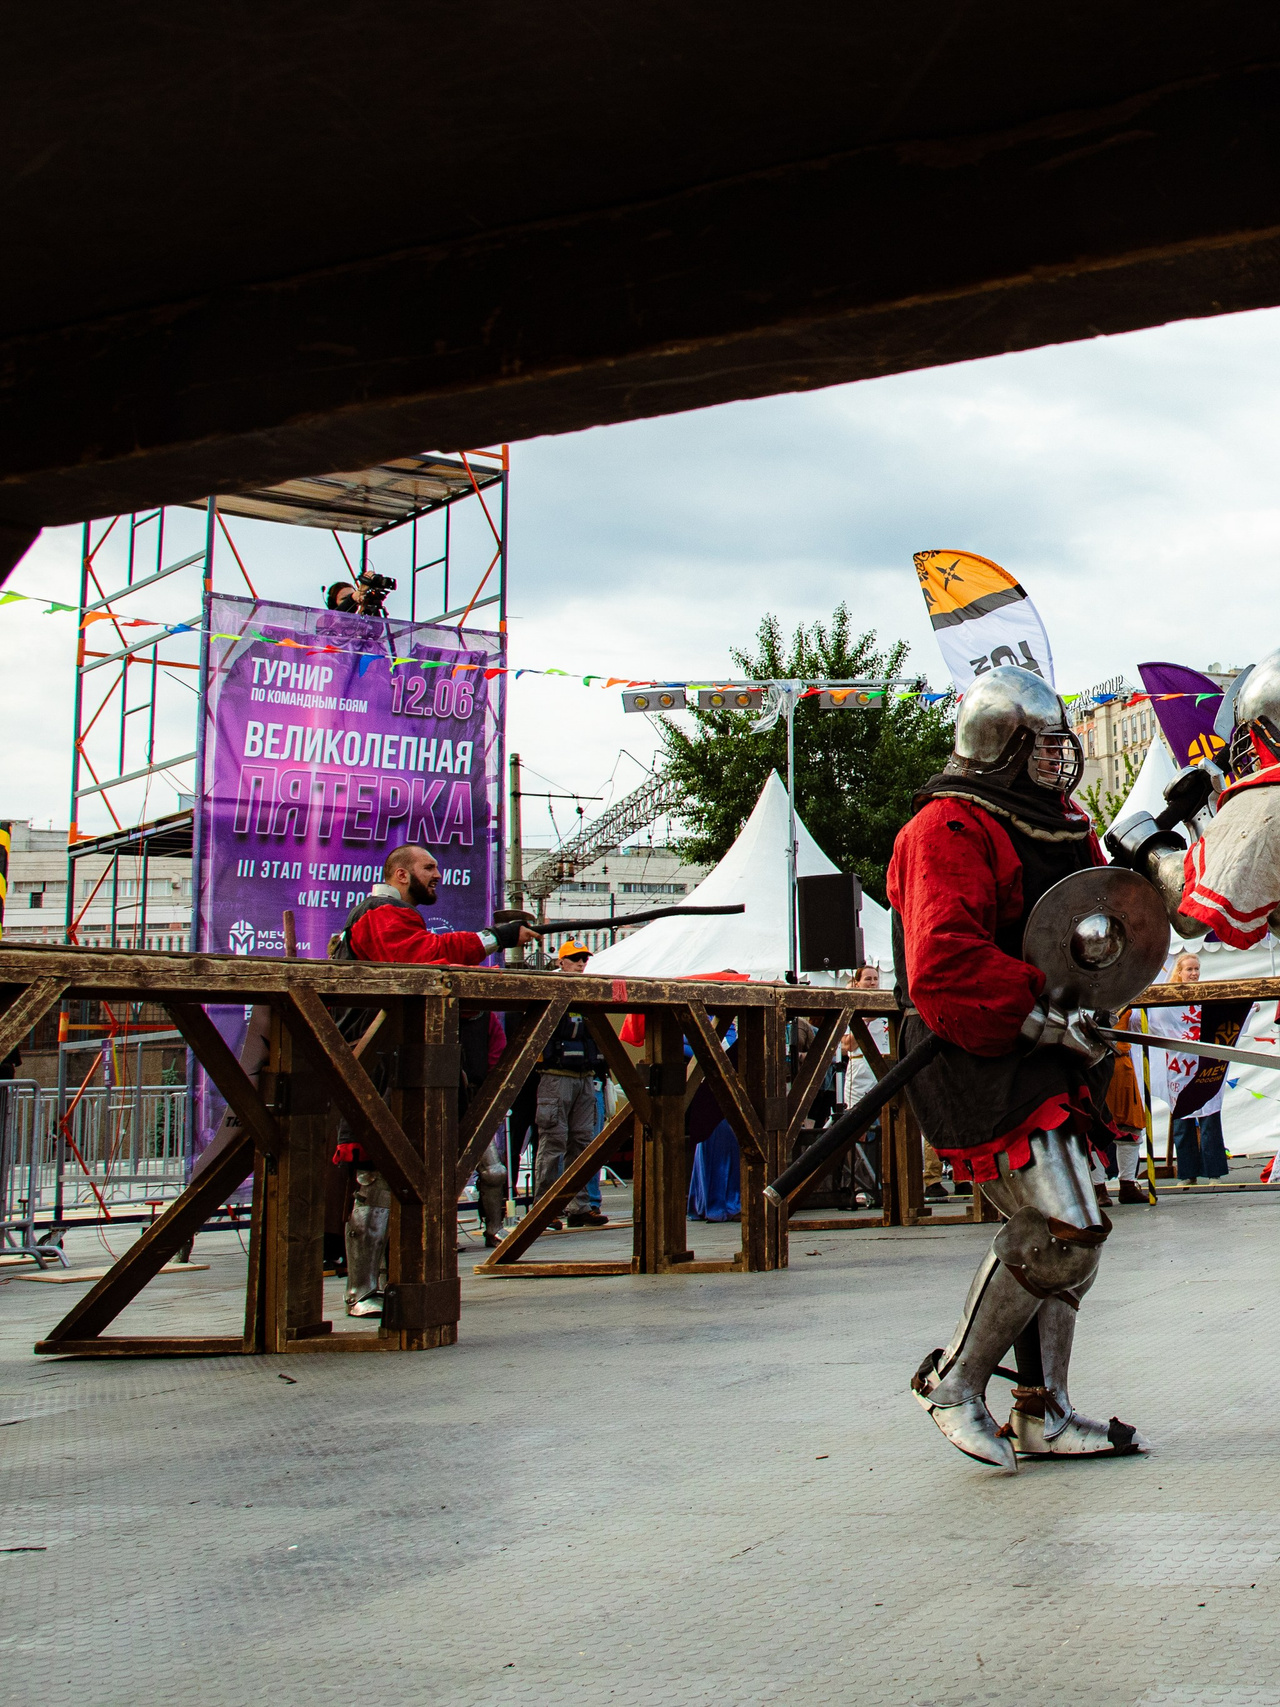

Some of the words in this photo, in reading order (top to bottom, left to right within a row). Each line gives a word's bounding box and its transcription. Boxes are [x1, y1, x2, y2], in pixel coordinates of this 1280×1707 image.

[251, 657, 333, 692] ТУРНИР
[250, 687, 266, 702] ПО
[267, 689, 338, 711] КОМАНДНЫМ
[339, 697, 369, 714] БОЯМ
[390, 674, 475, 720] 12.06
[243, 720, 474, 775] ВЕЛИКОЛЕПНАЯ
[232, 764, 475, 847] ПЯТЕРКА
[236, 859, 256, 878] III
[260, 860, 303, 880] ЭТАП
[308, 863, 386, 884] ЧЕМПИОН
[442, 868, 472, 886] ИСБ
[297, 889, 341, 908] «МЕЧ
[257, 930, 286, 939] МЕЧ
[1199, 1063, 1228, 1077] МЕЧ
